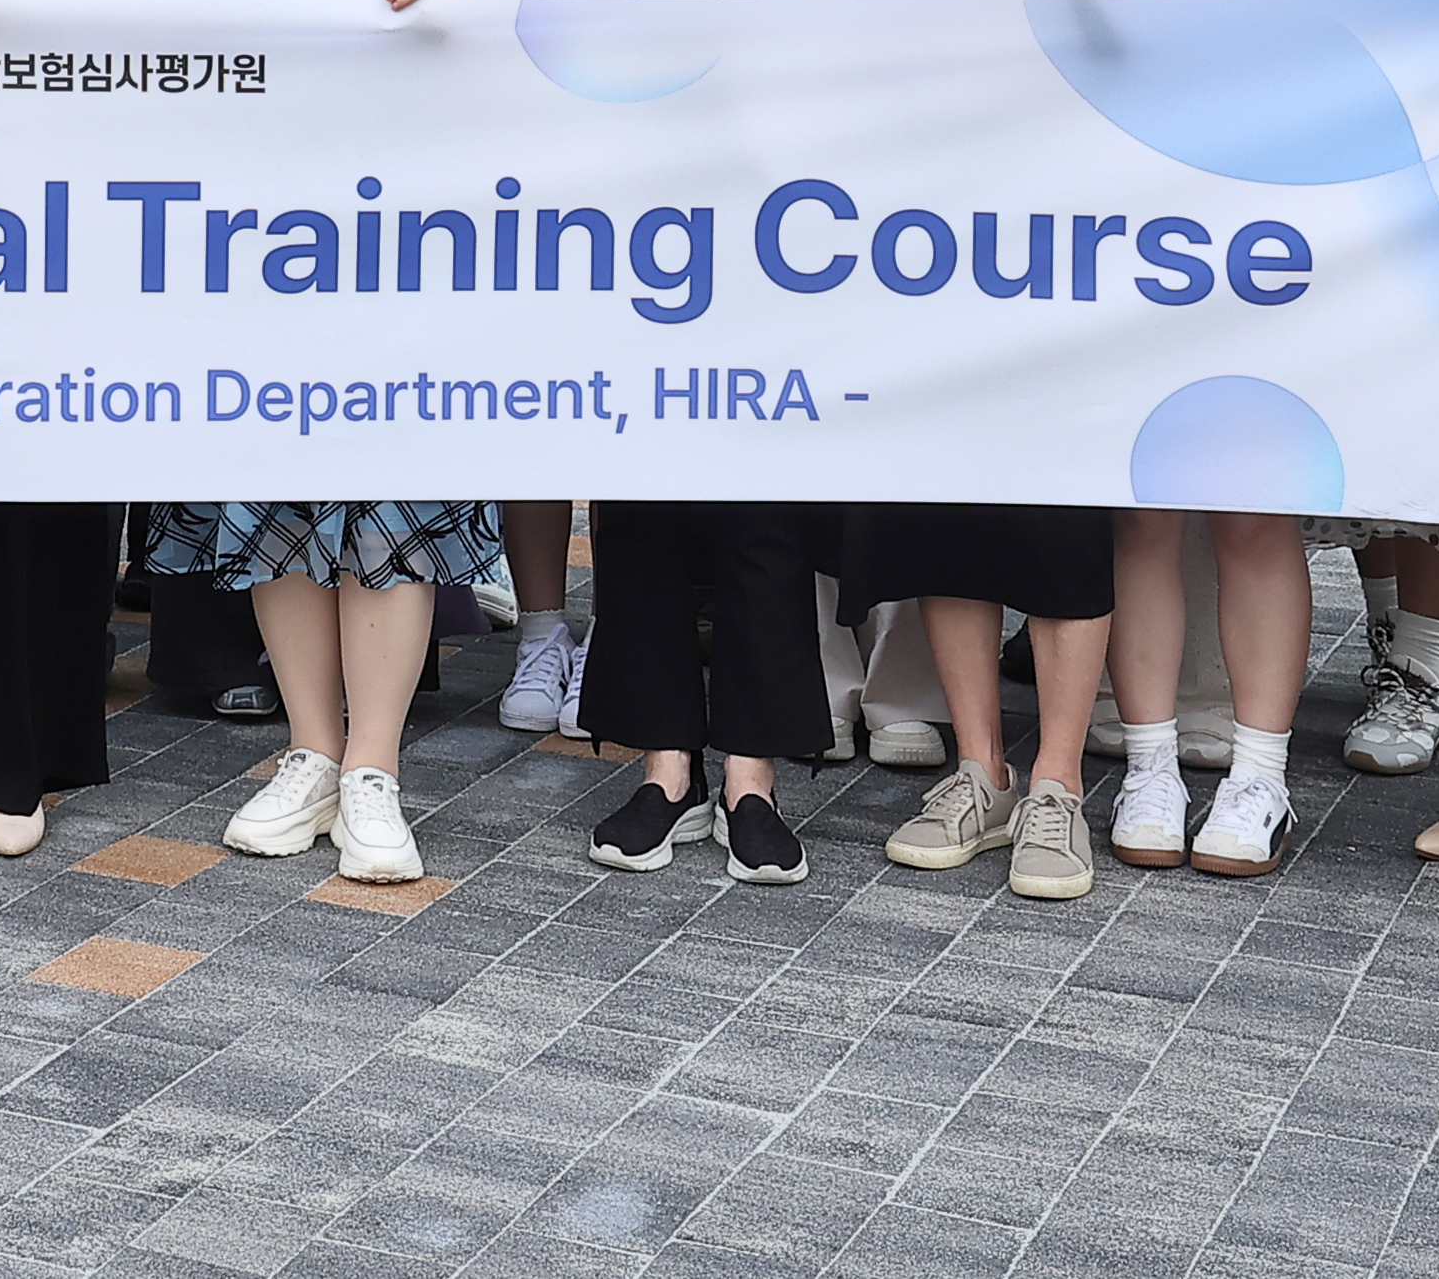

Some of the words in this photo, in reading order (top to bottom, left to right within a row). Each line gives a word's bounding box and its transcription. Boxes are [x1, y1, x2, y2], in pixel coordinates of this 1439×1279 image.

[106, 176, 714, 324] Training
[754, 179, 1313, 306] Course
[206, 369, 628, 436] Department,
[654, 367, 820, 423] HIRA
